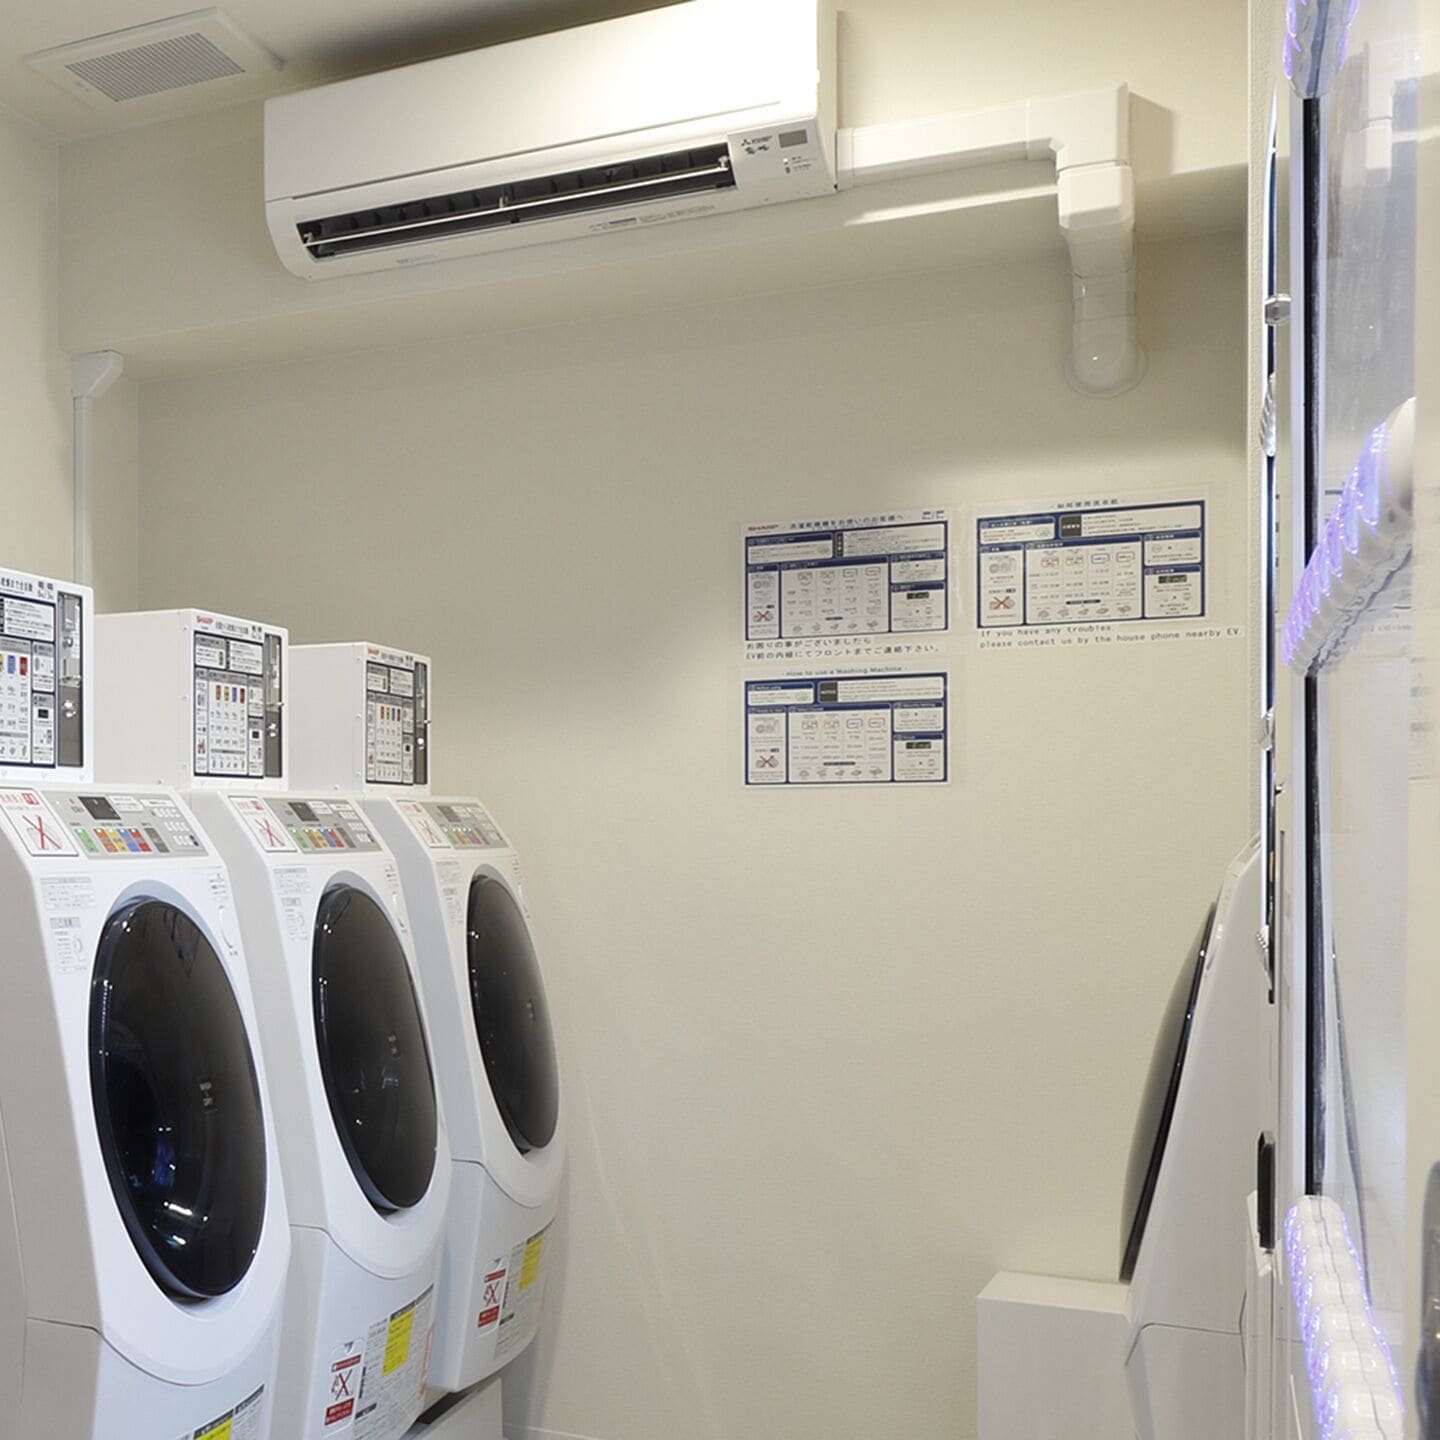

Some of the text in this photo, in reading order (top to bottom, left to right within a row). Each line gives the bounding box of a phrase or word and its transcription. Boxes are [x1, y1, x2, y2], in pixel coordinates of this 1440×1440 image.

[980, 640, 1013, 648] please
[1017, 638, 1056, 646] contact
[1116, 634, 1146, 642] house
[1151, 632, 1181, 641] phone
[1186, 629, 1222, 638] nearby
